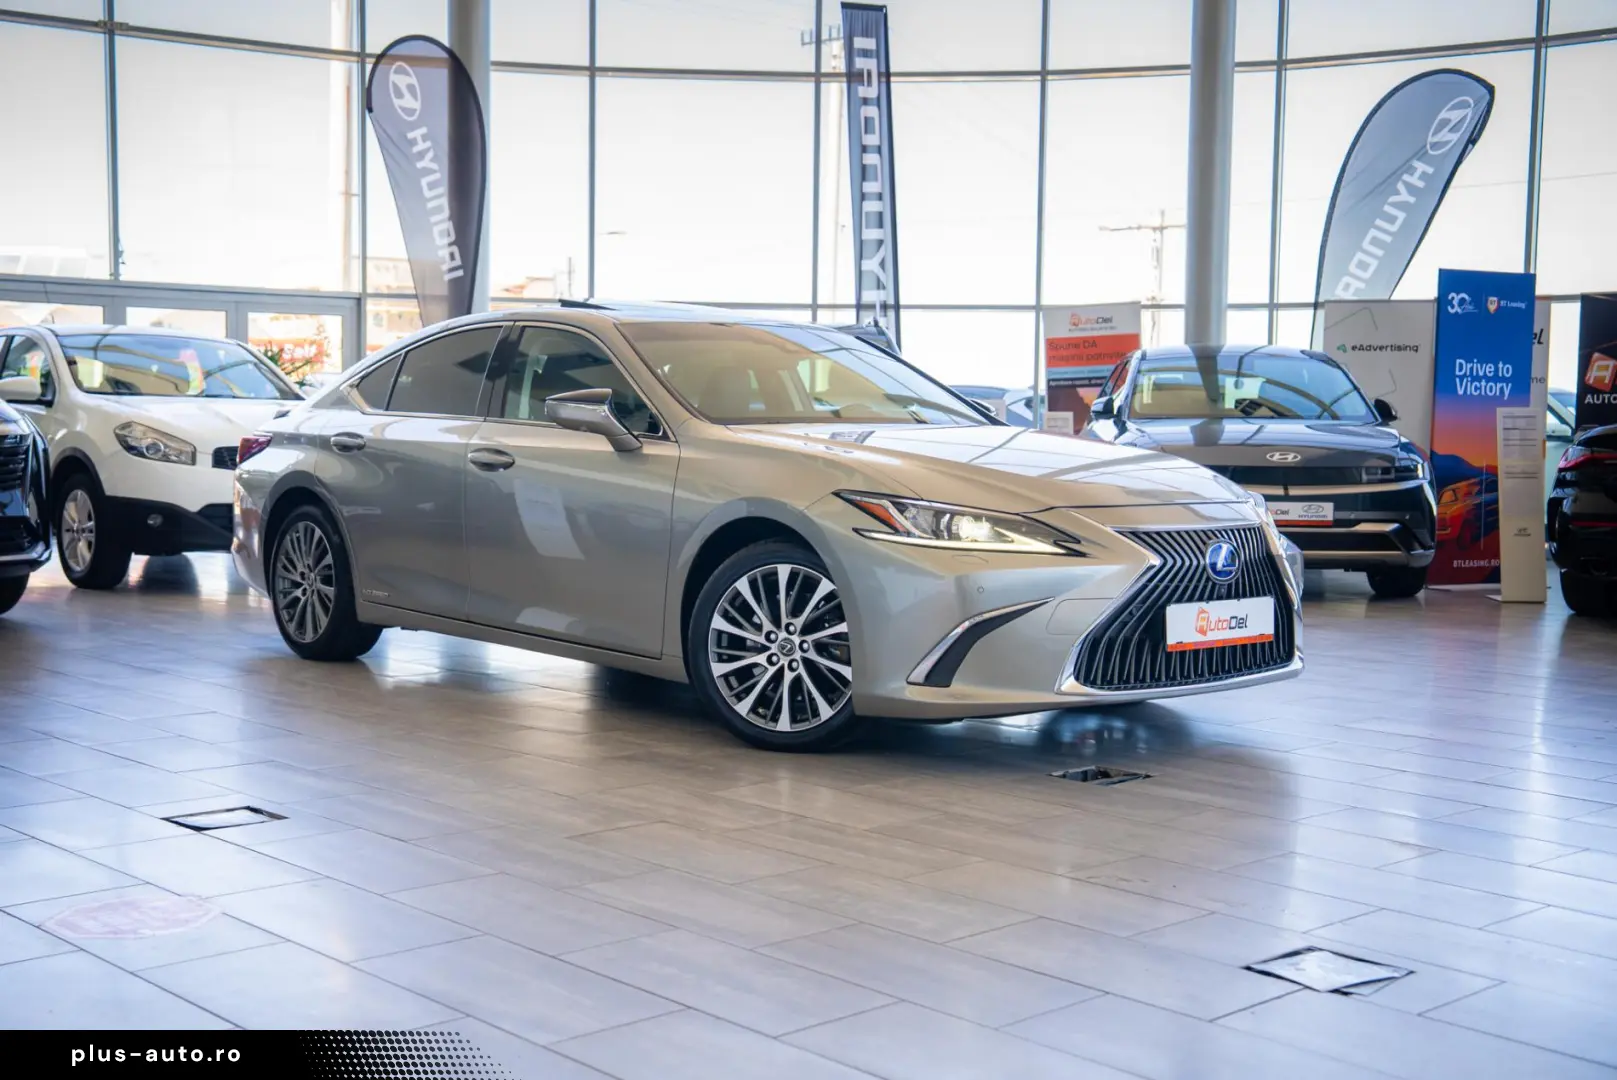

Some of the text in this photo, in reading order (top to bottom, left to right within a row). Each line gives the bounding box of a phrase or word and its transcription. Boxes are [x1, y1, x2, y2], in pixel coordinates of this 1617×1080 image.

[406, 126, 464, 282] HYUNDAI
[1083, 339, 1098, 349] DA
[1351, 343, 1419, 354] eAdvertising
[1455, 358, 1513, 378] Drive to
[1455, 377, 1512, 400] Victory
[1195, 606, 1248, 637] AutoDel
